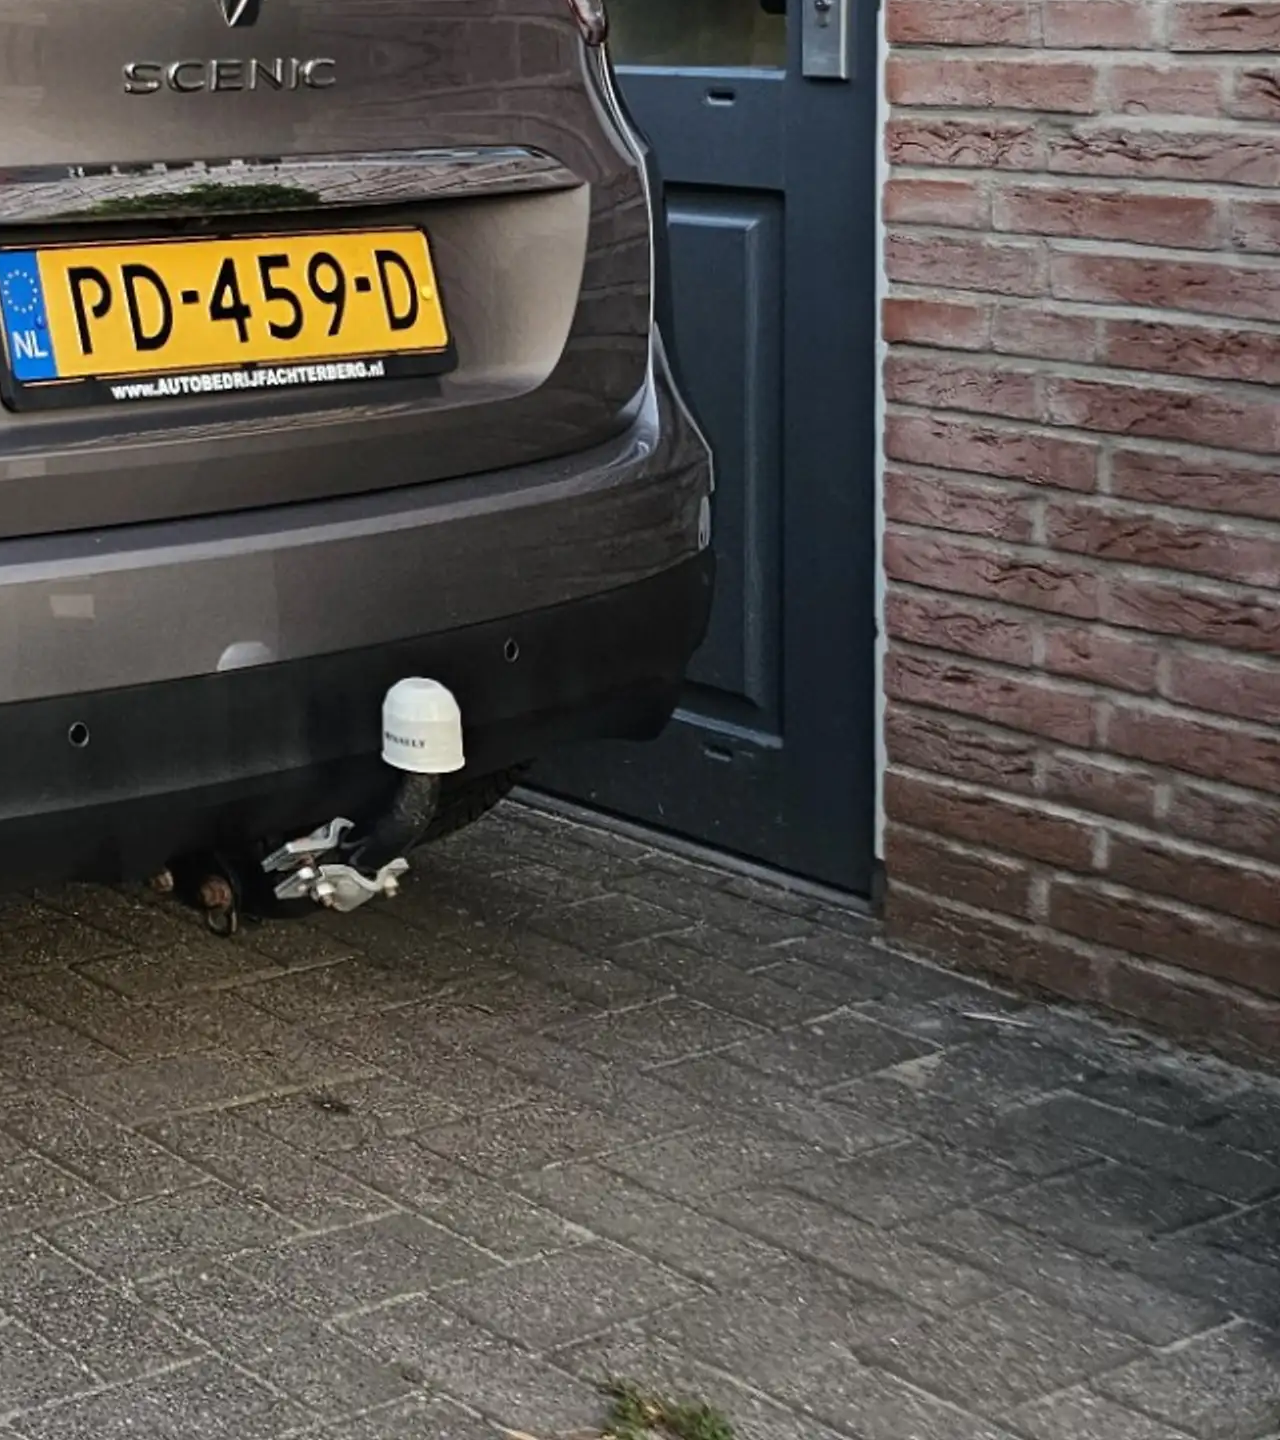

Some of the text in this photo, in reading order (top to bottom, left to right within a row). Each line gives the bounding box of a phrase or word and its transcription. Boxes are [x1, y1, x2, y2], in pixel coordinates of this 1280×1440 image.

[124, 58, 337, 95] SCENIC
[66, 248, 420, 356] PD-459-D
[12, 329, 49, 361] NL
[110, 360, 386, 401] www.AUTOBEDRIJFACHTERBERG.nl
